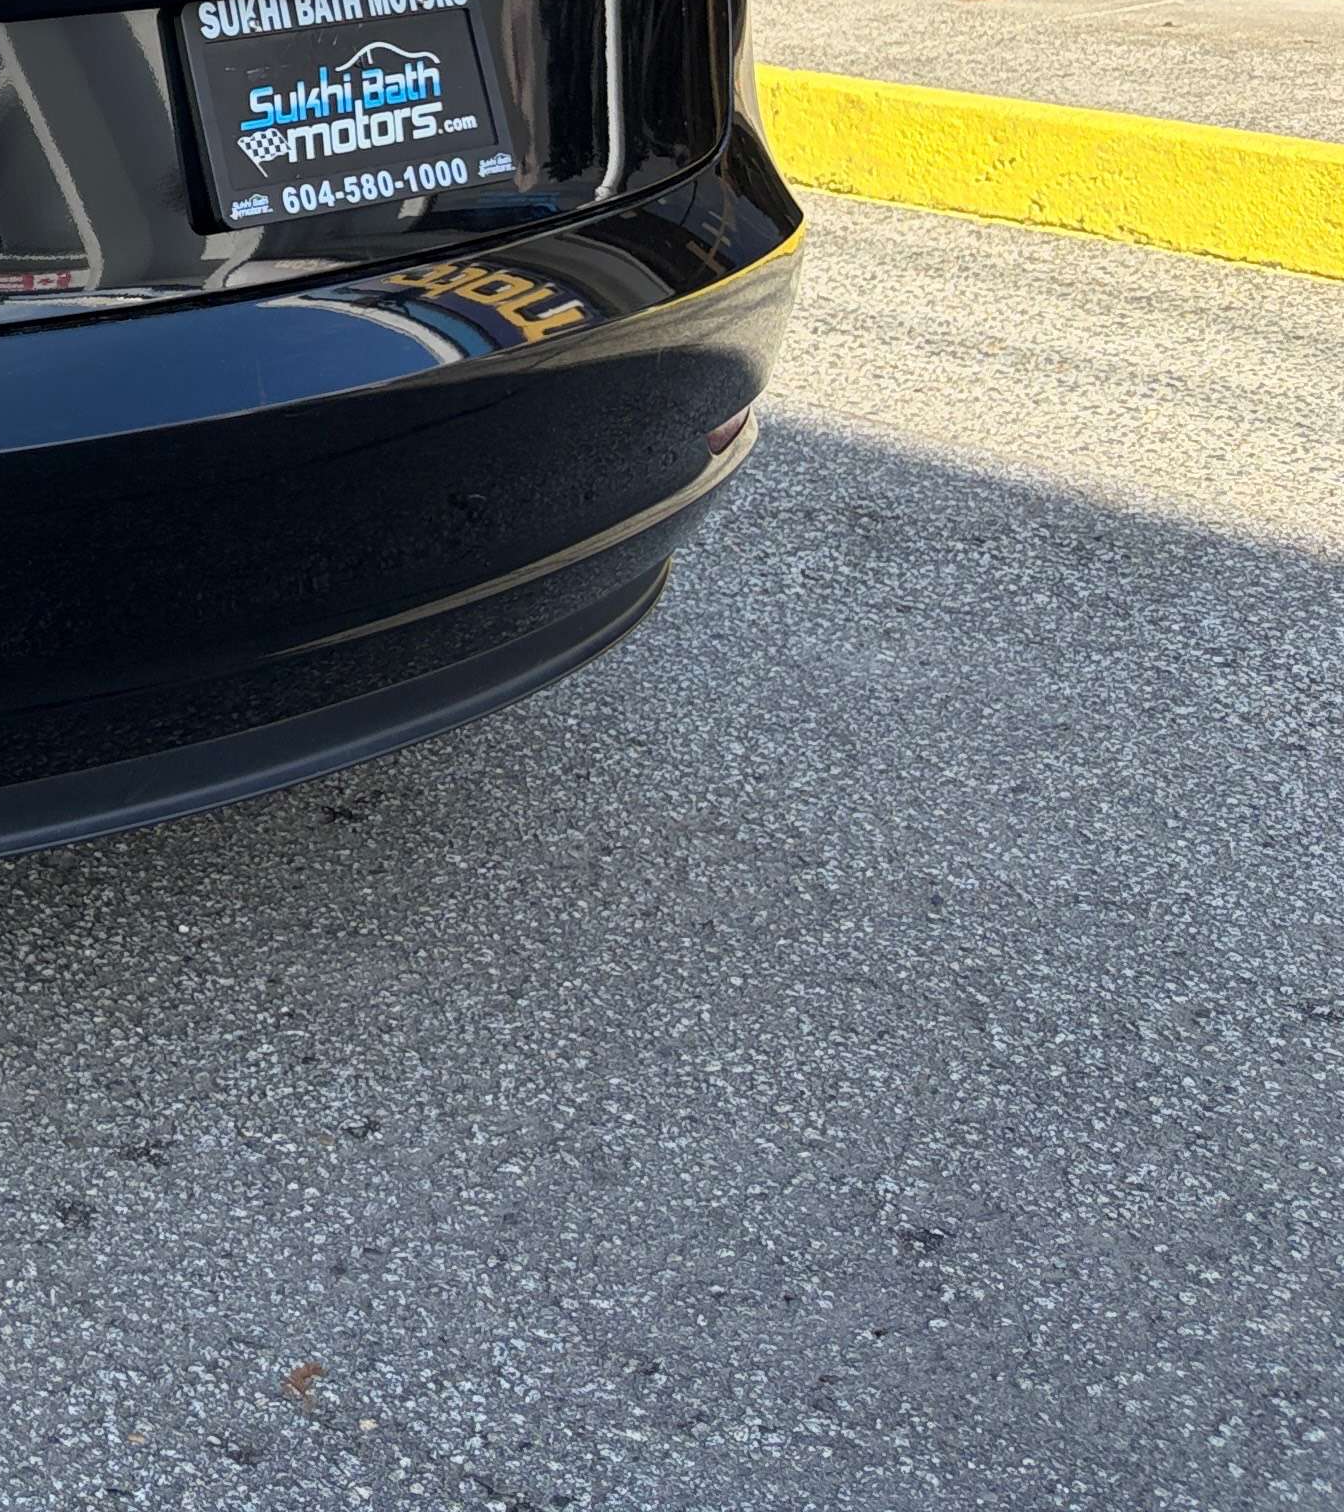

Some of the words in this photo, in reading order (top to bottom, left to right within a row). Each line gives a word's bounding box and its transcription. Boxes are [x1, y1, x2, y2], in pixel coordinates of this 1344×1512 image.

[240, 65, 352, 131] Sukhi
[362, 60, 442, 108] Bath
[282, 157, 468, 215] 604-580-1000
